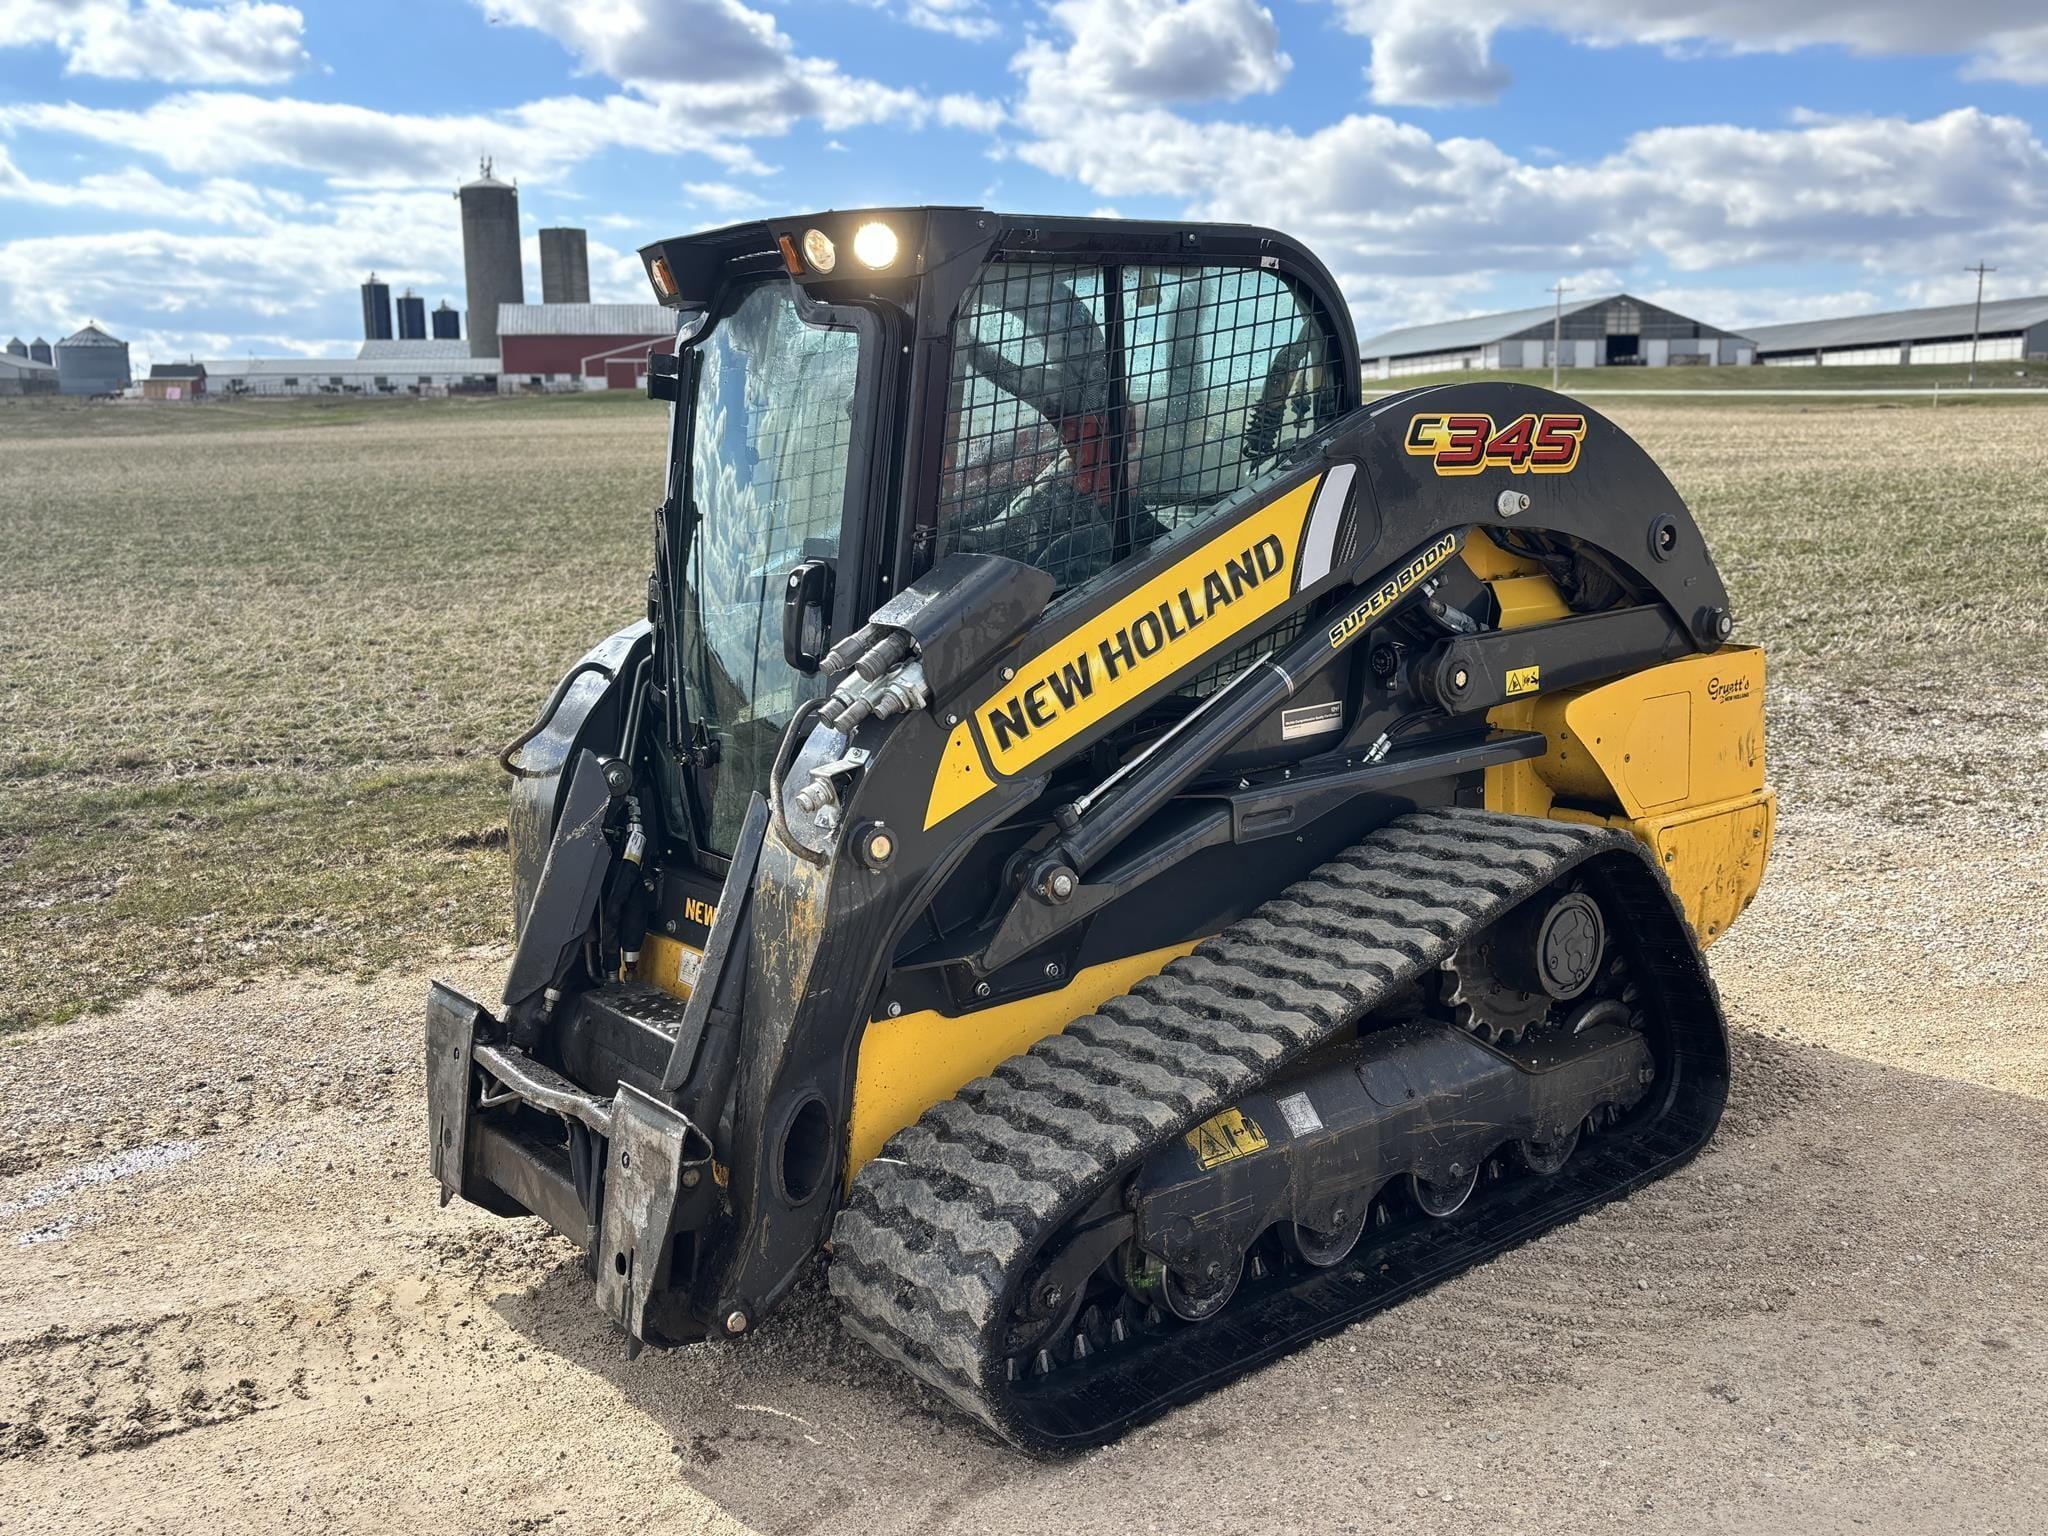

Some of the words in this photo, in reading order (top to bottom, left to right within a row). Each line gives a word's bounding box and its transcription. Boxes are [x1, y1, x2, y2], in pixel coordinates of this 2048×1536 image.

[1404, 413, 1587, 476] C345
[1329, 581, 1399, 648] SUPER
[1397, 533, 1456, 592] BOOM
[988, 650, 1095, 753] NEW
[1098, 533, 1285, 682] HOLLAND
[684, 897, 718, 927] NEW
